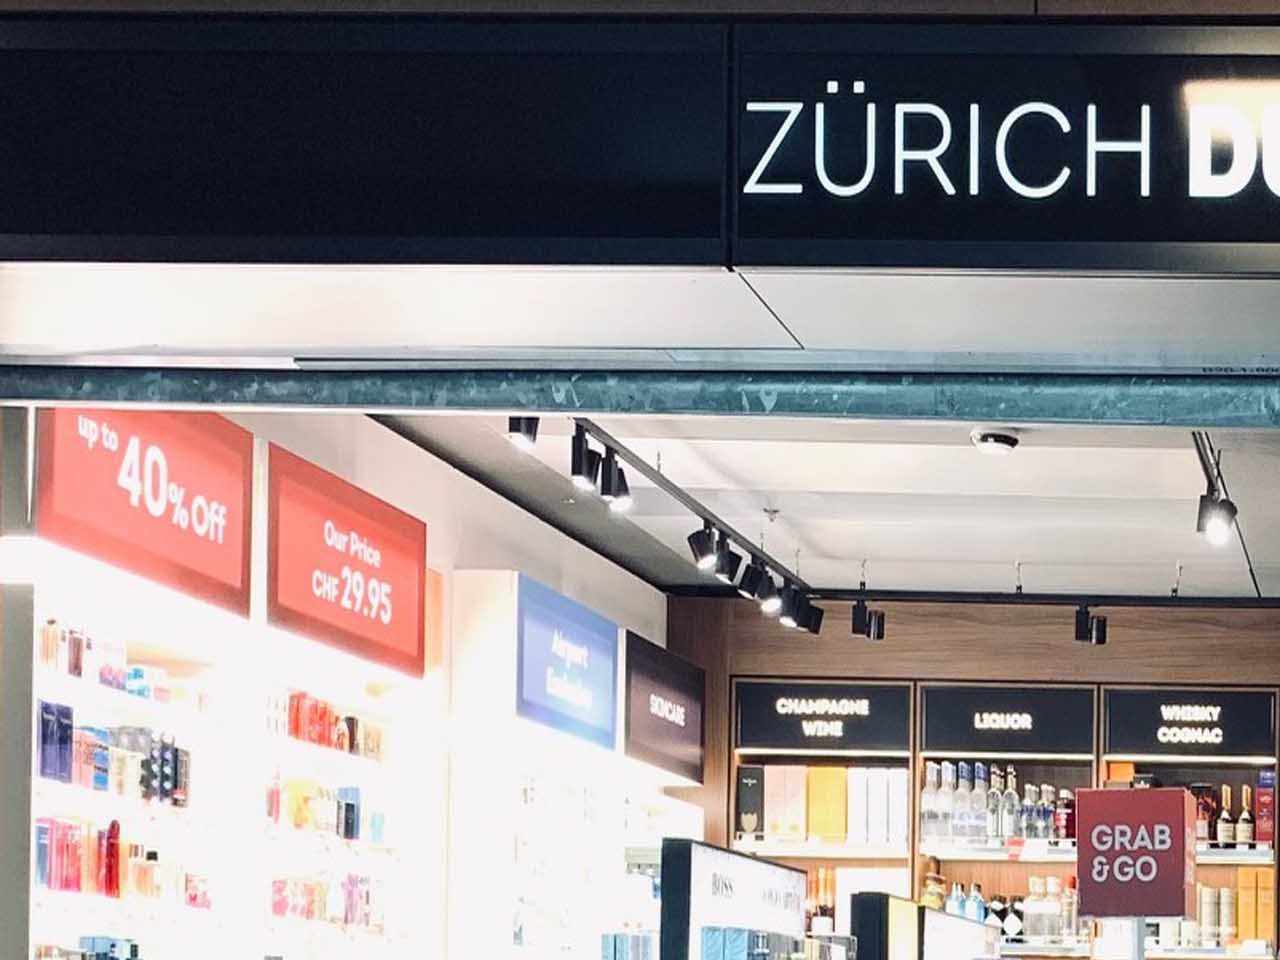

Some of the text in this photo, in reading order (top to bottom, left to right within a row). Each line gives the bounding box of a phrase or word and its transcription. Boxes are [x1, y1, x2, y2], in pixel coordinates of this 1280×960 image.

[743, 80, 1150, 199] ZÜRICH
[77, 414, 98, 451] up
[101, 423, 119, 452] to
[191, 494, 227, 545] Off
[323, 519, 382, 569] Our Price
[312, 565, 393, 625] CHF 29.95
[775, 697, 870, 716] CHAMPAGNE
[1160, 704, 1222, 722] WHISKY
[801, 719, 844, 738] WINE
[973, 712, 1033, 730] LIQUOR
[1156, 726, 1223, 744] COGNAC
[1091, 824, 1172, 851] GRAB
